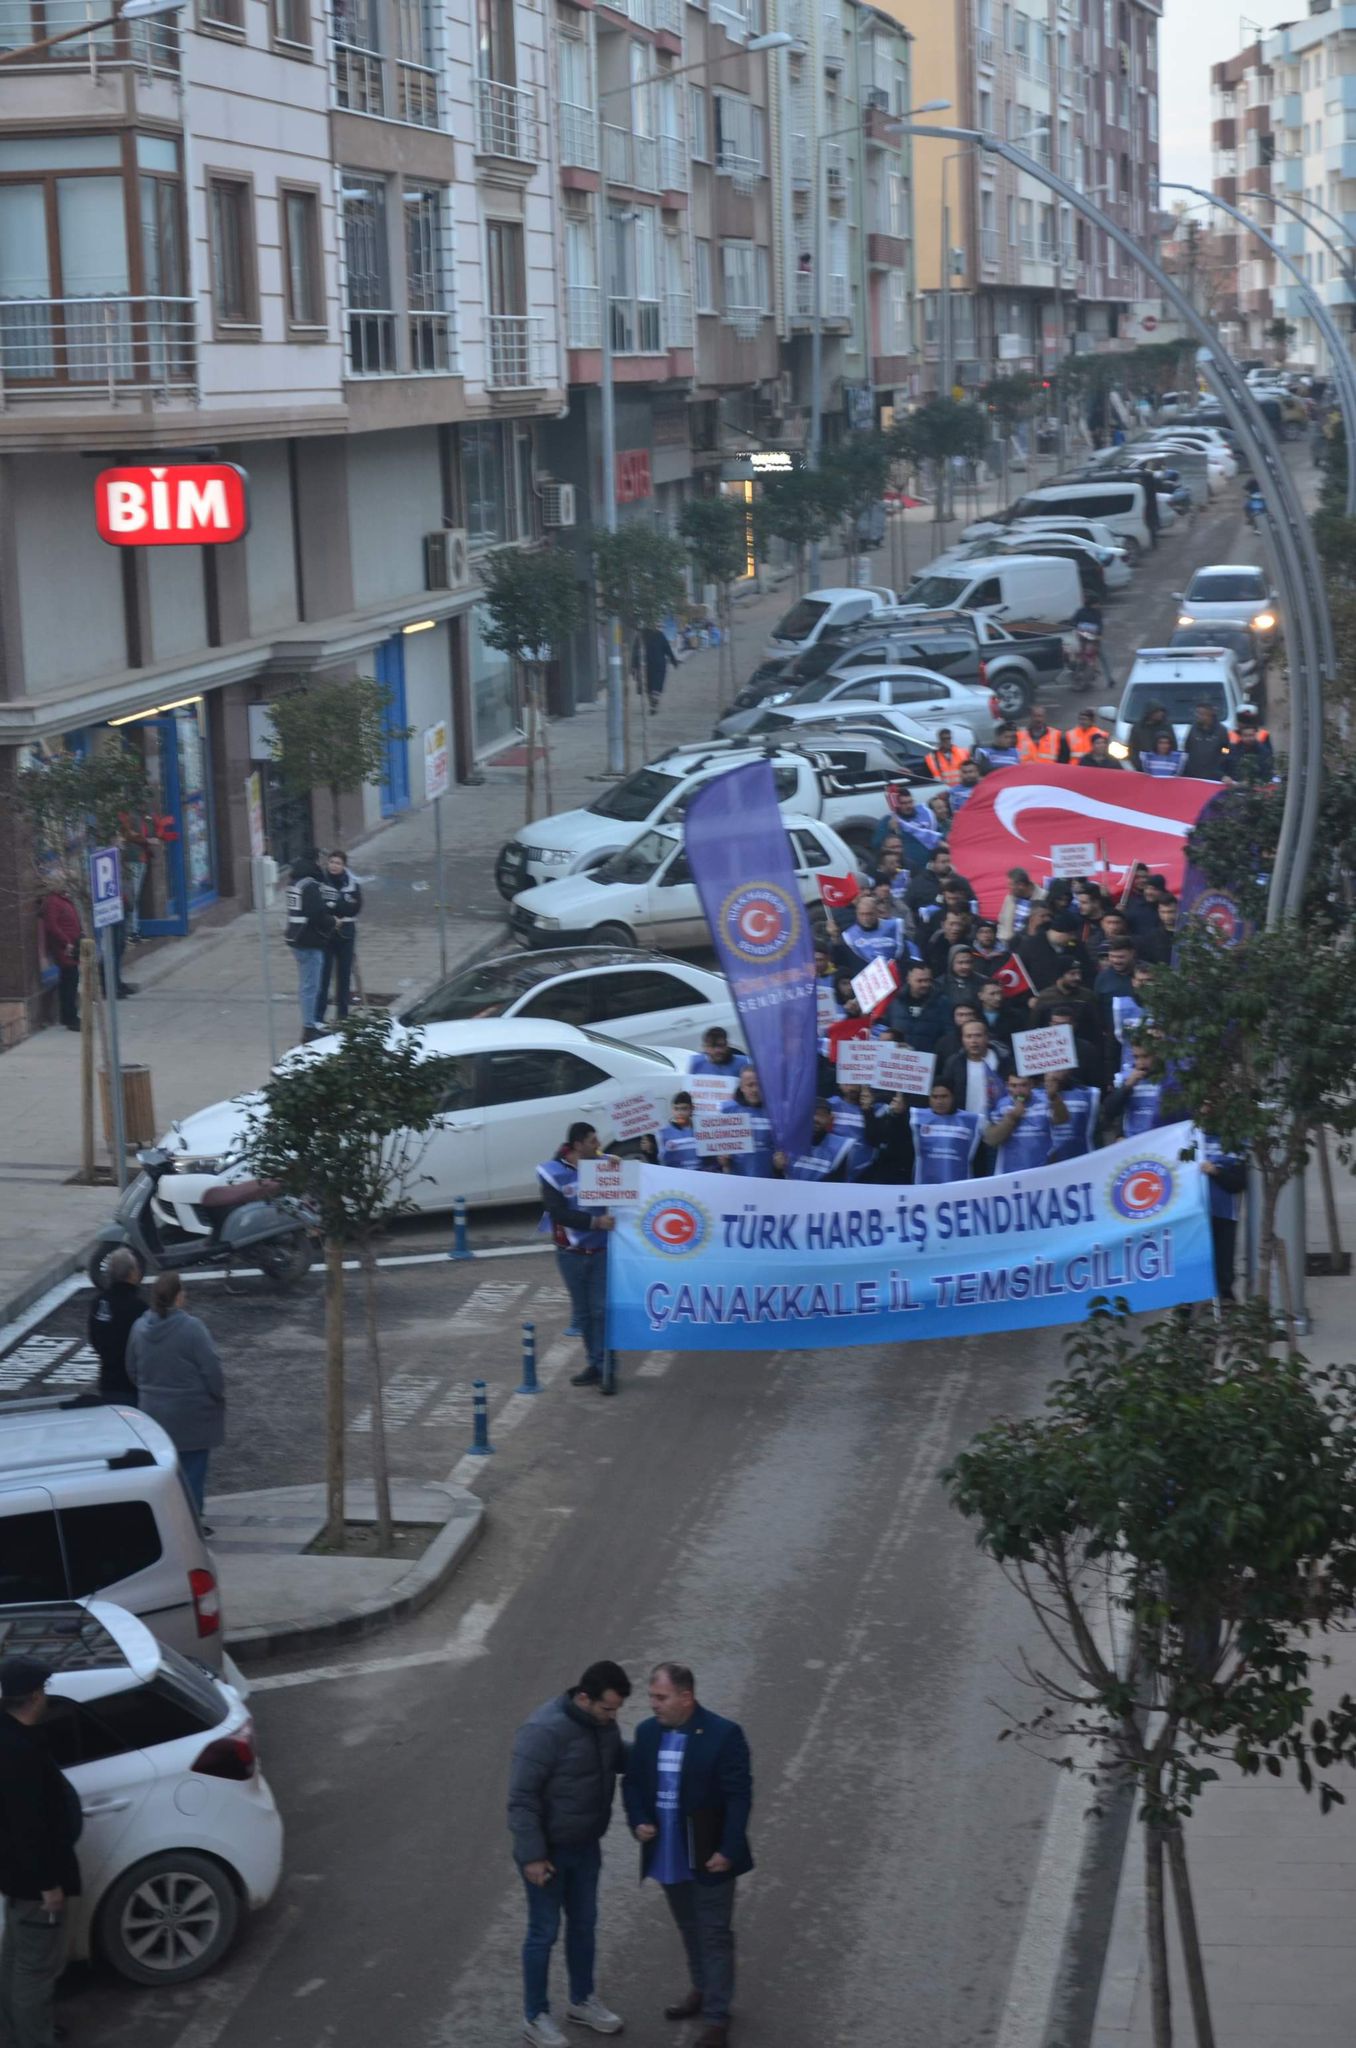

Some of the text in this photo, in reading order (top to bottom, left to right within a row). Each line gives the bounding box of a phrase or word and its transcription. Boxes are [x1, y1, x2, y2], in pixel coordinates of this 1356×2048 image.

[107, 467, 231, 532] BİM
[737, 984, 815, 1012] SENDİKAS
[721, 1204, 800, 1250] TÜRK
[806, 1195, 928, 1252] HARB-İŞ
[935, 1181, 1095, 1240] SENDİKASI
[646, 1229, 1176, 1331] ÇANAKKALE İL TEMSİLCİLİĞİ
